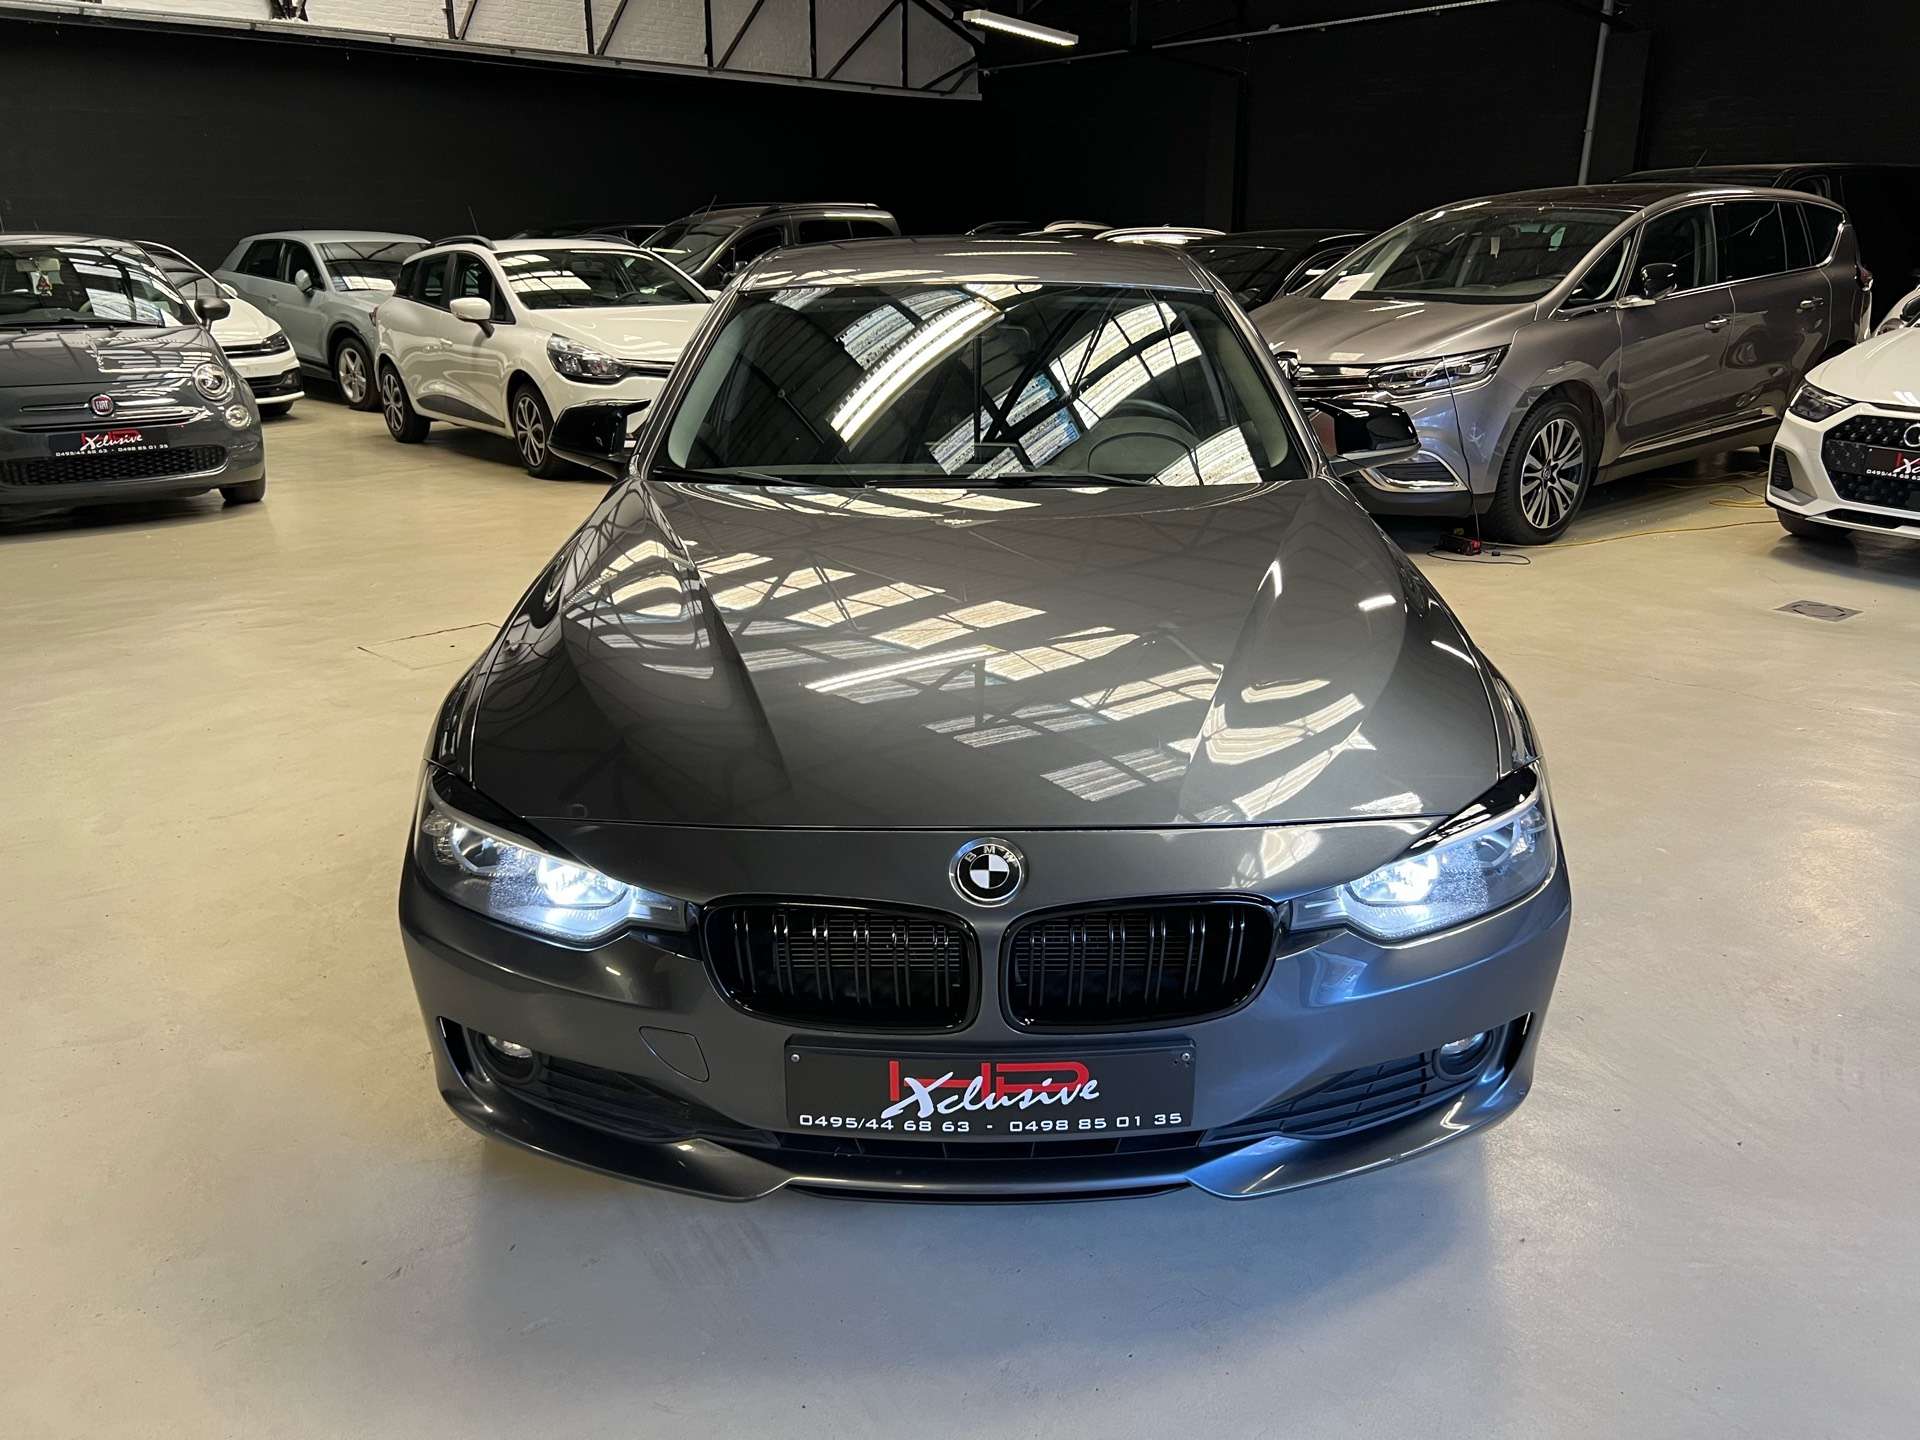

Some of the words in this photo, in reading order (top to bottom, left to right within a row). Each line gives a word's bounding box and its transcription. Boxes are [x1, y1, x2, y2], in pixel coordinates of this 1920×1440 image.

[95, 400, 109, 411] FIAT
[80, 434, 143, 451] Xclusive
[964, 845, 1018, 867] BMW
[880, 1071, 1100, 1119] Xclusive
[799, 1114, 895, 1131] 0495/44
[903, 1120, 932, 1132] 68
[941, 1120, 970, 1133] 63
[1009, 1118, 1069, 1132] 0498
[1078, 1117, 1107, 1130] 85
[1116, 1115, 1142, 1128] 01
[1153, 1112, 1182, 1126] 35
